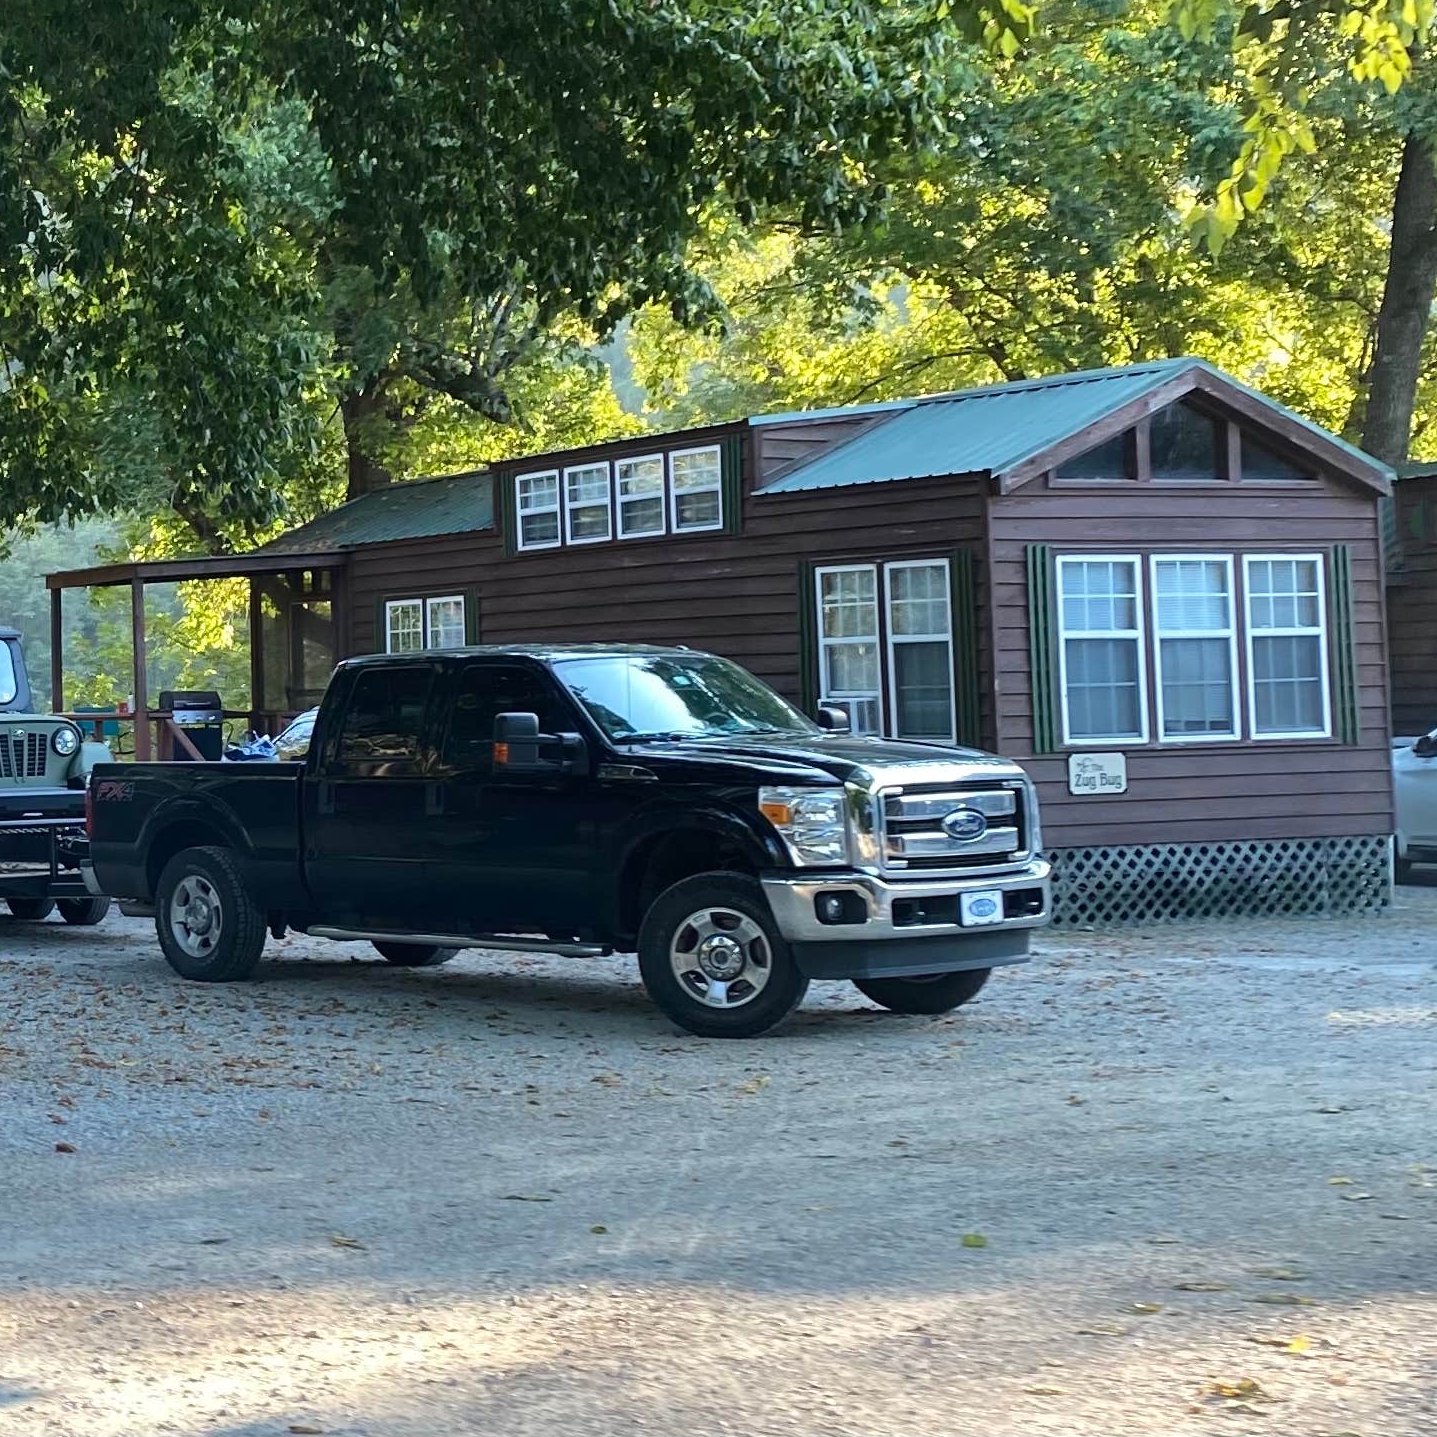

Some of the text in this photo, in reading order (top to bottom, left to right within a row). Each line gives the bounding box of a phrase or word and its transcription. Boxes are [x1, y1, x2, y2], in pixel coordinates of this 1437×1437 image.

[98, 781, 135, 799] FX4
[1075, 772, 1123, 790] Zug Bug
